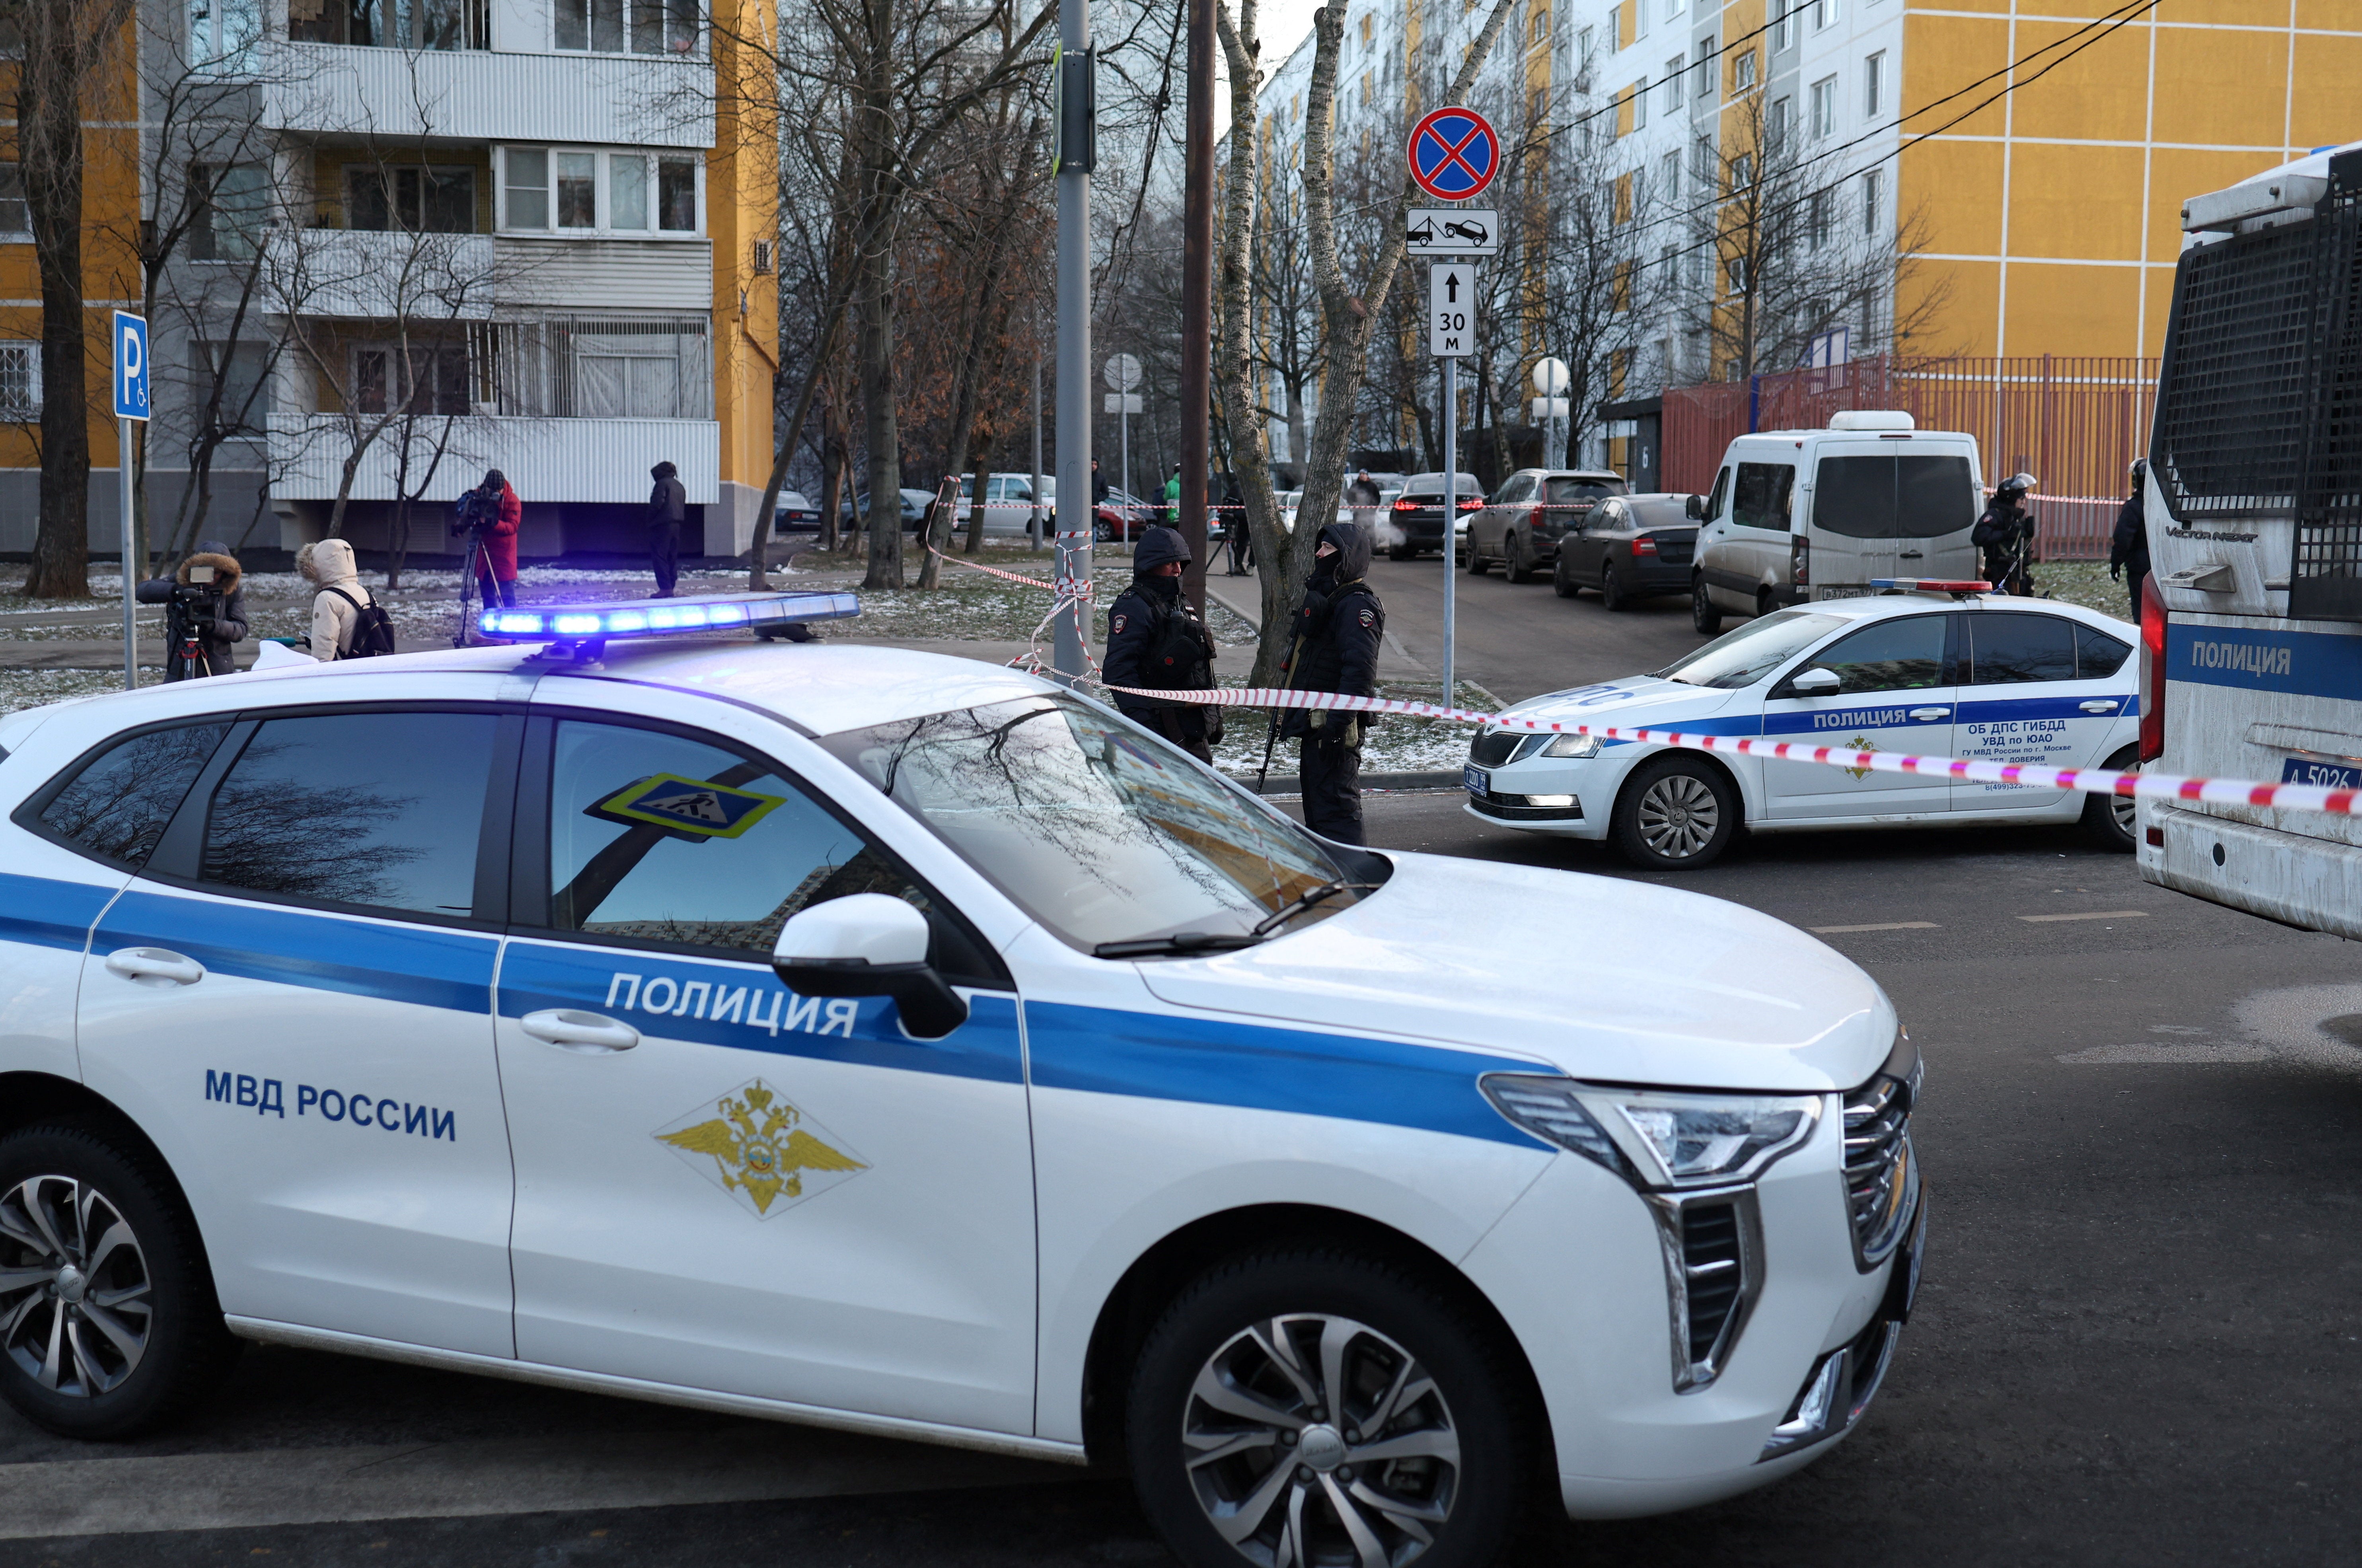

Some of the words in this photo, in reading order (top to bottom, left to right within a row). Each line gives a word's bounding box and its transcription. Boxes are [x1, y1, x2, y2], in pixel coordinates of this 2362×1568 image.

[1440, 313, 1465, 331] 30
[1445, 338, 1458, 350] М
[124, 326, 141, 405] P
[1642, 446, 1648, 469] 6
[2192, 641, 2291, 677] ПОЛИЦИЯ
[1814, 709, 1906, 728] ПОЛИЦИЯ
[1969, 724, 1986, 734] ОБ
[1991, 722, 2018, 735] ДПС
[2023, 720, 2066, 732] ГИБДД
[1982, 736, 2005, 747] УВД
[2027, 734, 2052, 743] ЮАО
[1994, 746, 2021, 755] России
[1469, 769, 1478, 787] 2200
[1481, 773, 1486, 786] 99
[605, 972, 859, 1038] ПОЛИЦИЯ
[205, 1069, 284, 1119] МВД
[298, 1084, 456, 1142] РОССИИ
